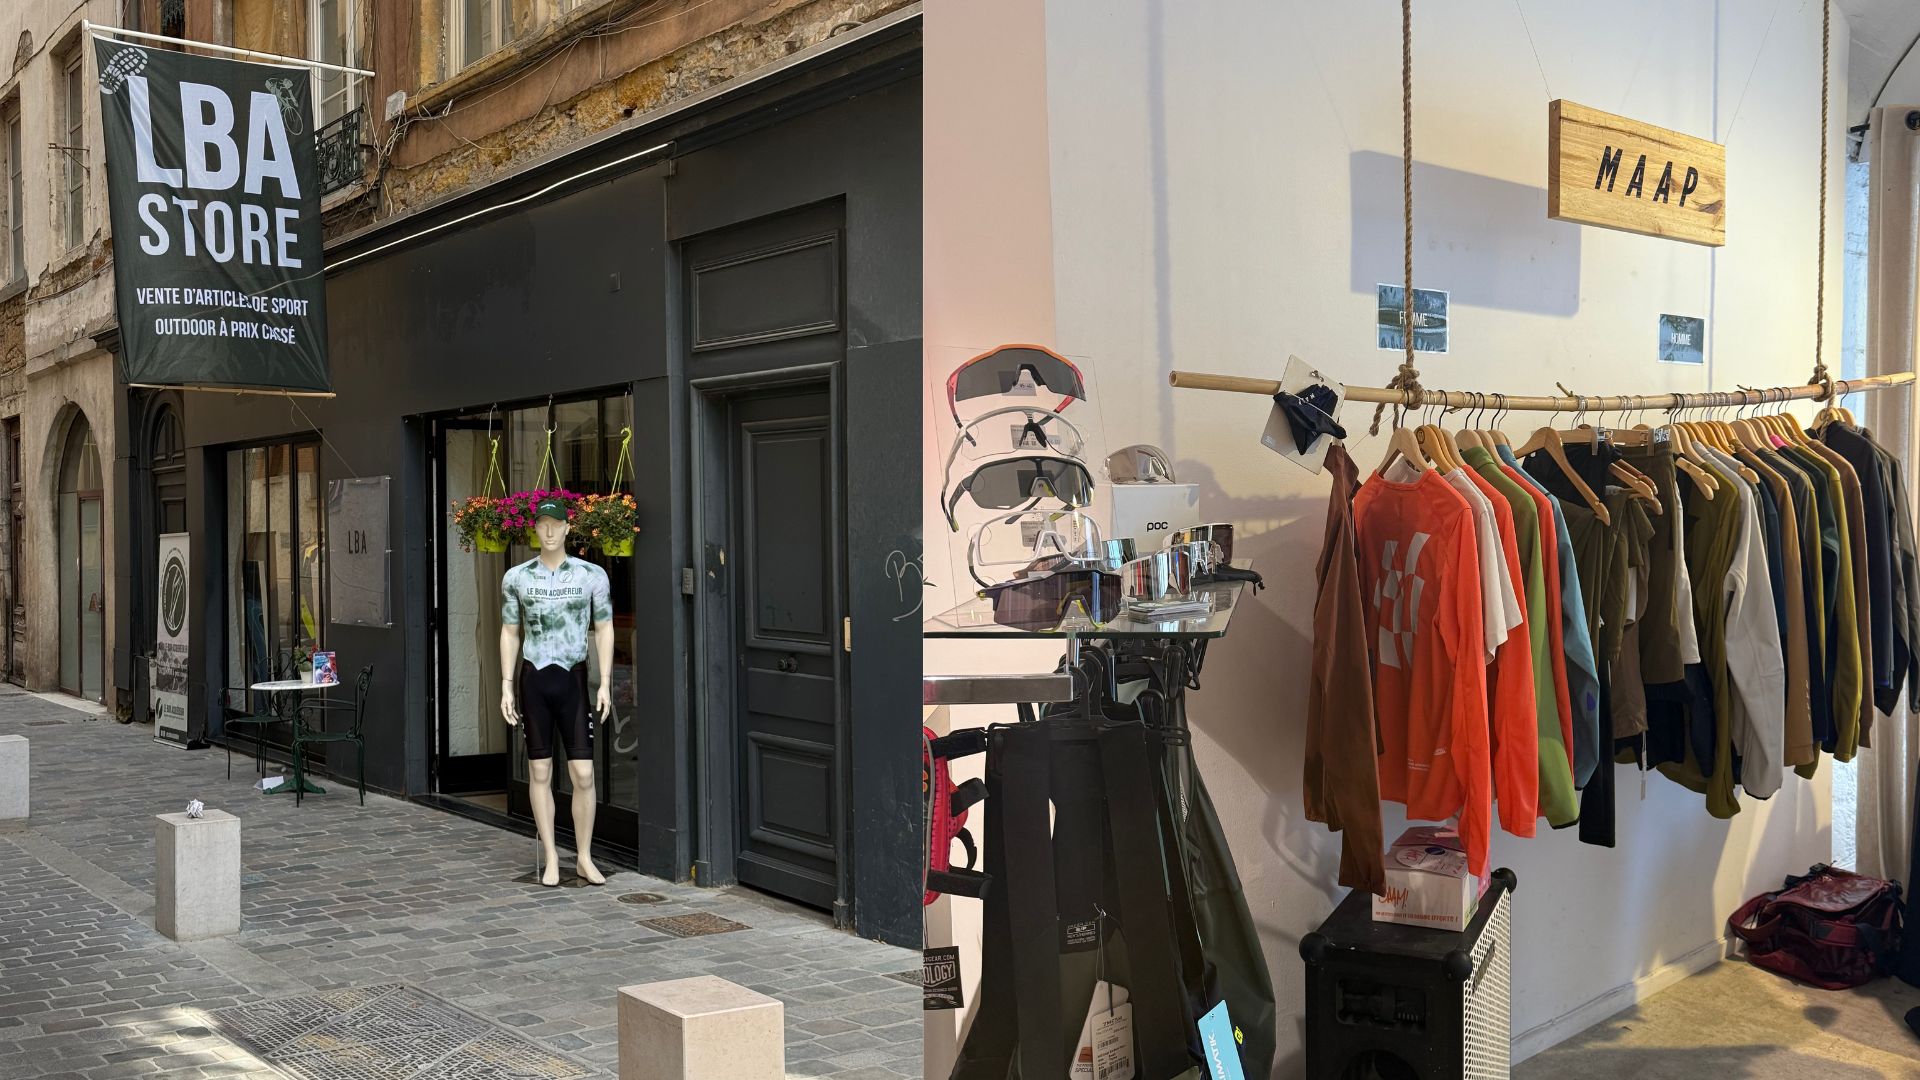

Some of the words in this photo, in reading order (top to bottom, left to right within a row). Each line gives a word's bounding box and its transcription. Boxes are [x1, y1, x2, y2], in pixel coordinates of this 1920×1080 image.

[127, 75, 301, 199] LBA
[1594, 145, 1699, 207] MAAP
[138, 193, 302, 268] STORE
[136, 287, 180, 305] VENTE
[252, 296, 269, 313] DE
[271, 297, 309, 316] SPORT
[155, 318, 217, 337] OUTDOOR
[219, 316, 229, 337] À
[231, 321, 260, 339] PRIX
[348, 529, 368, 555] LBA
[527, 587, 535, 596] LE
[535, 588, 548, 597] BON
